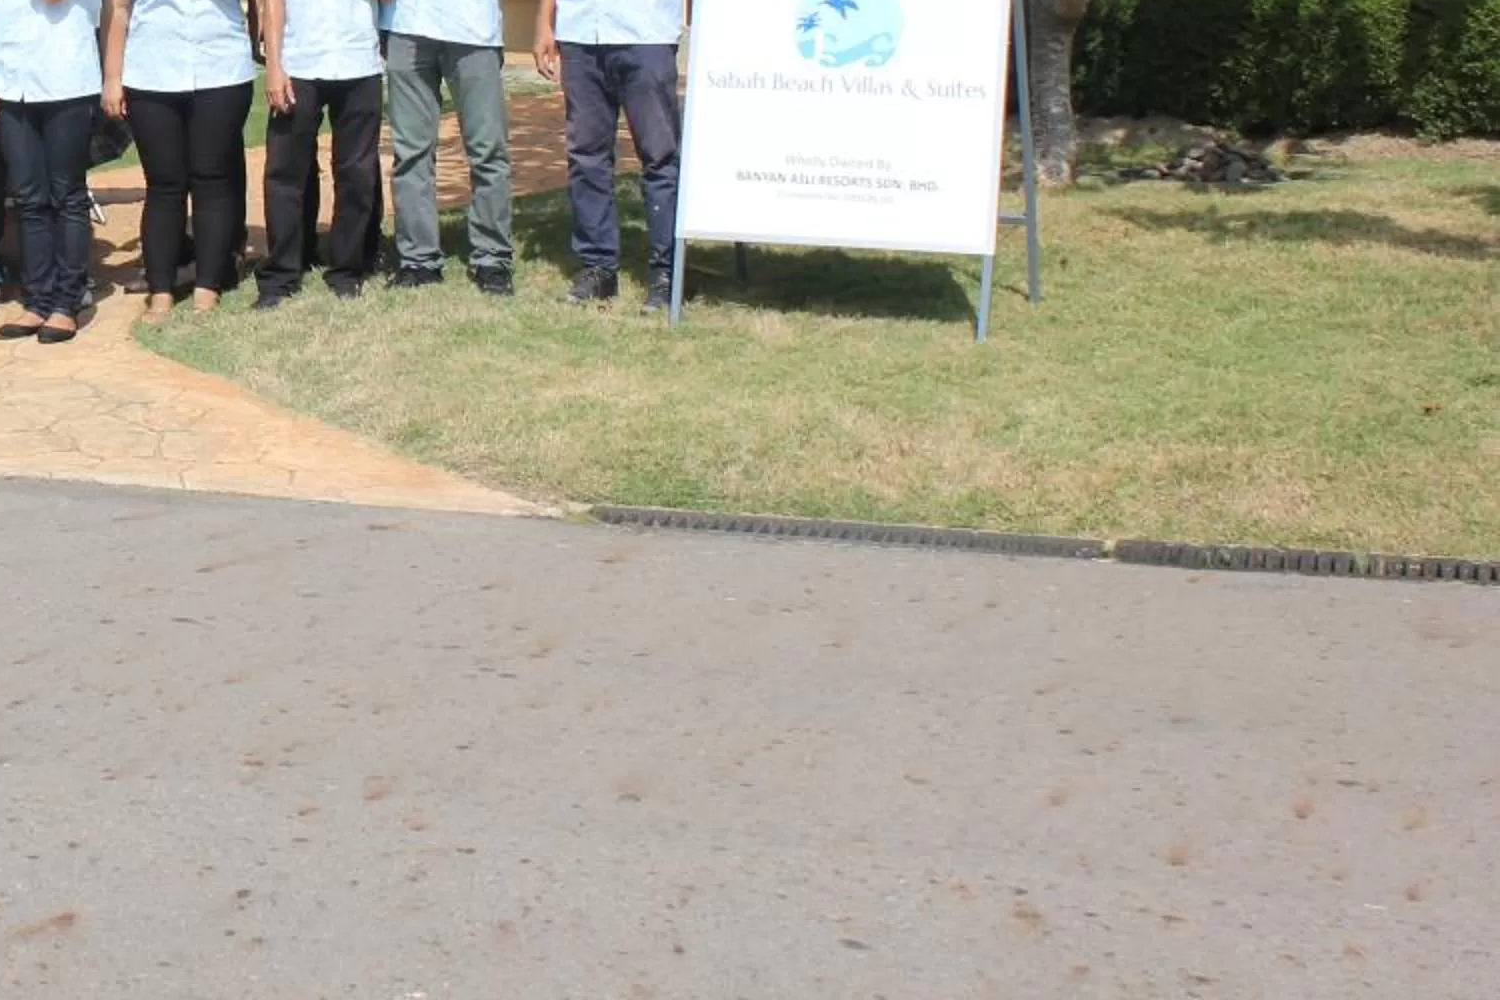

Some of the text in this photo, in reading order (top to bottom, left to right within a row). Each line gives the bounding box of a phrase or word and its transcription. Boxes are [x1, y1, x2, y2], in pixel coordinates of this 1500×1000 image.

[706, 70, 988, 100] Sabah Beach Villas & Suites
